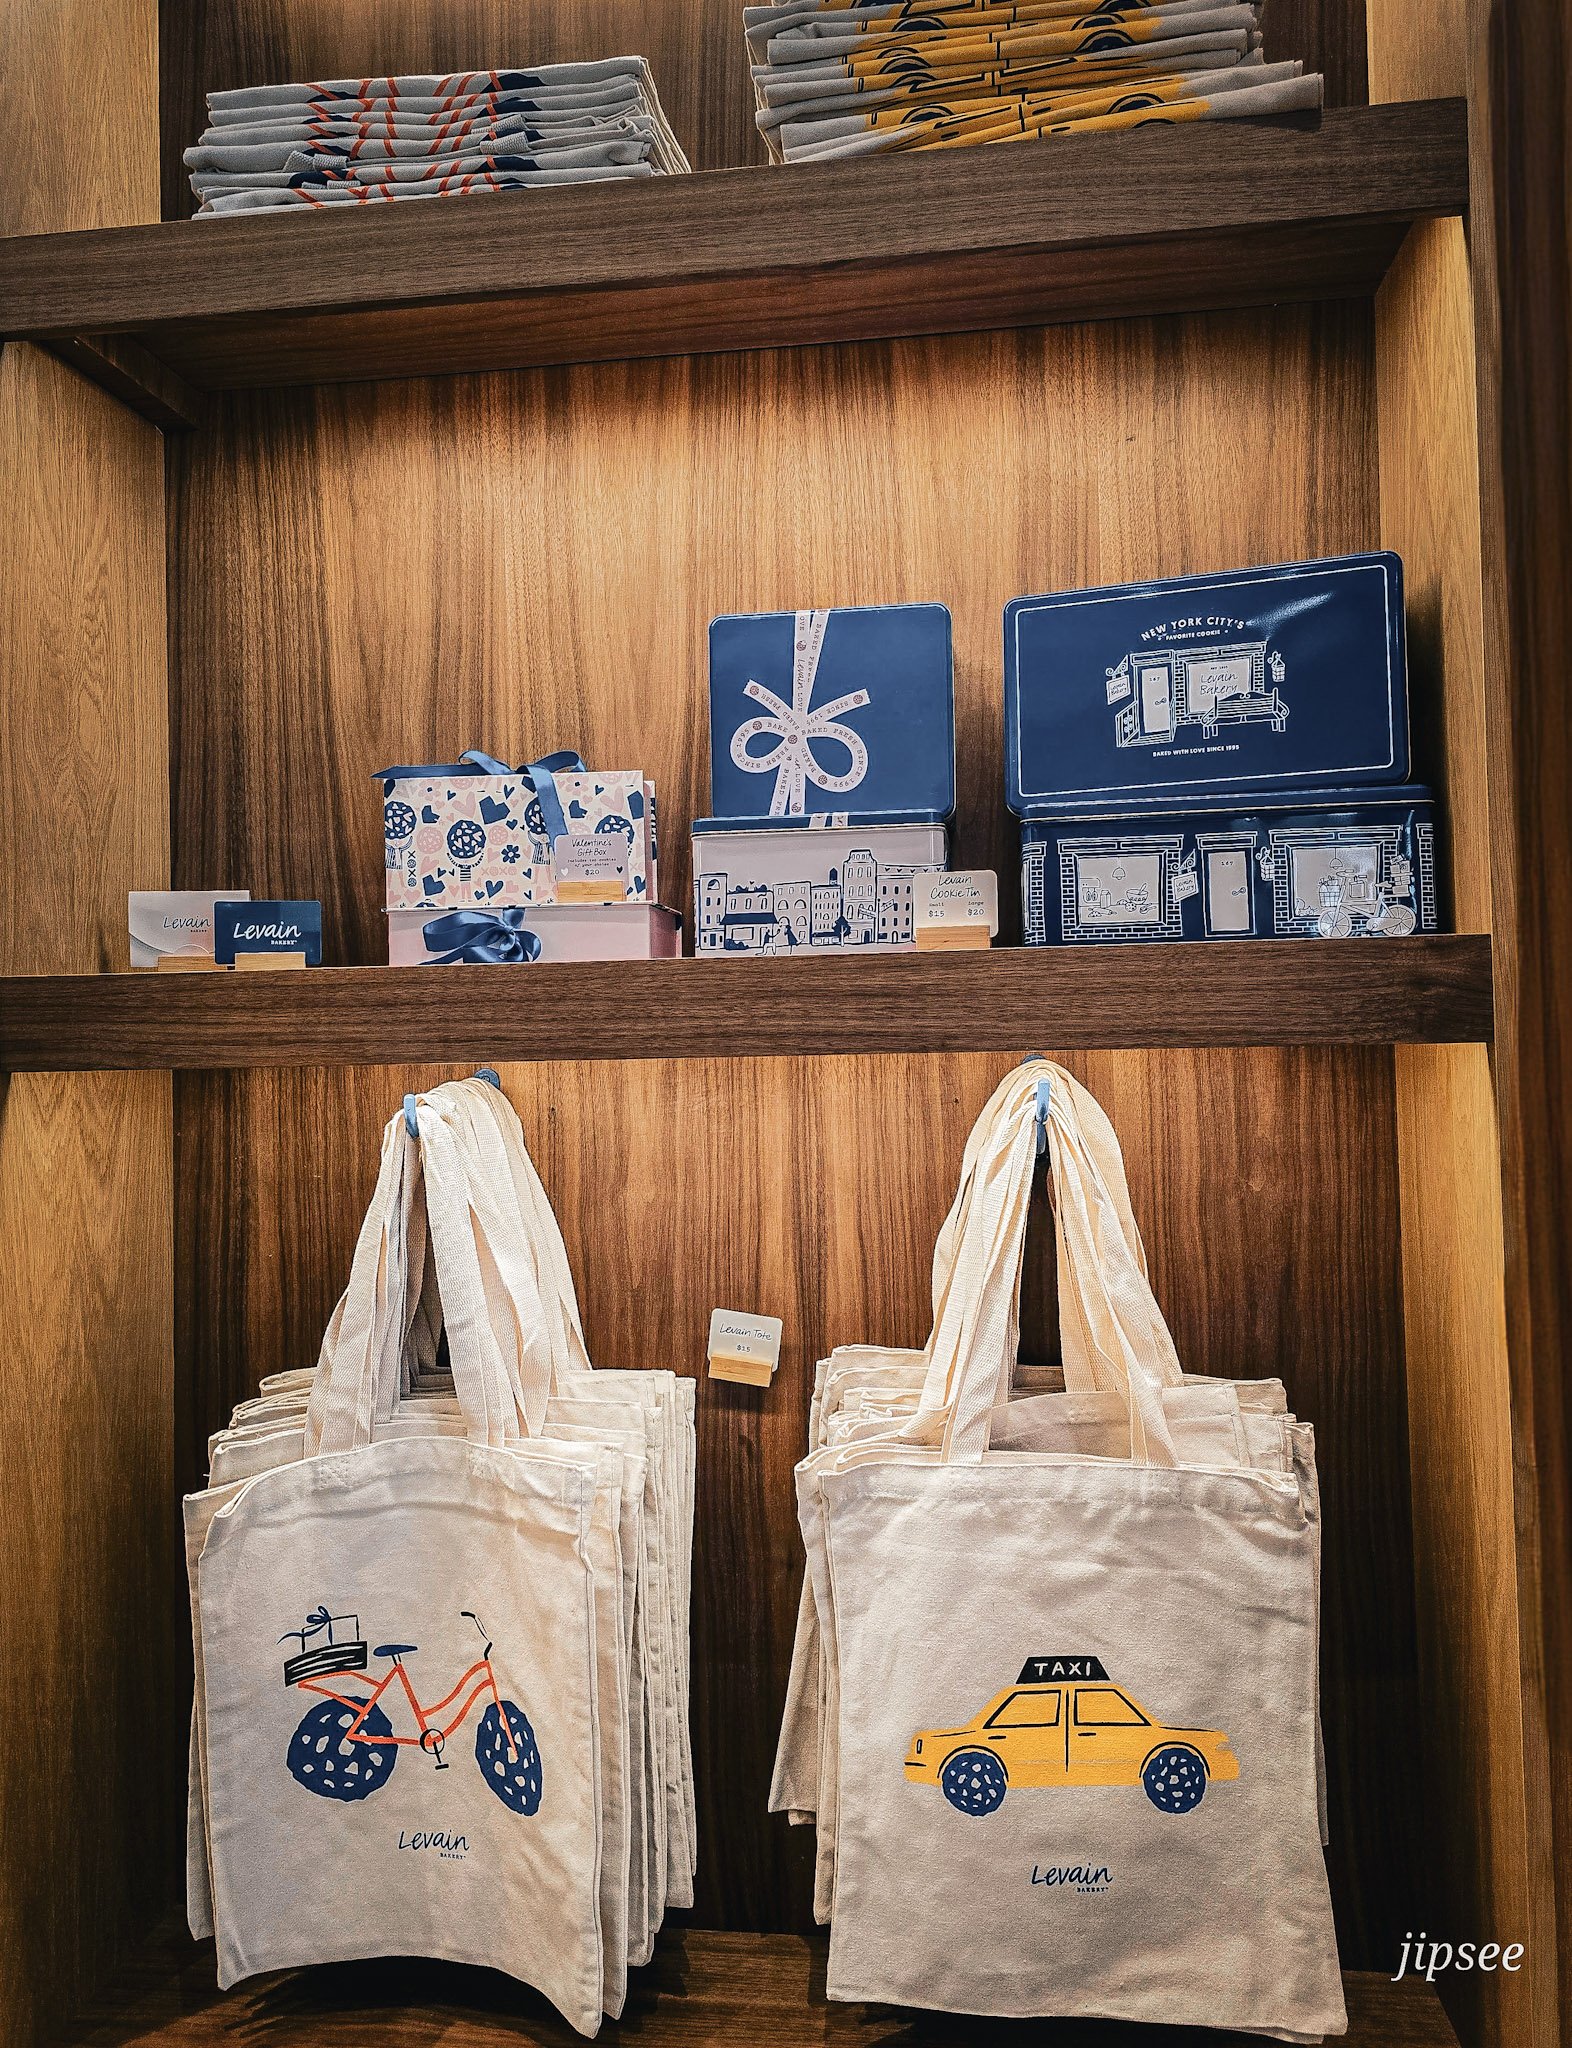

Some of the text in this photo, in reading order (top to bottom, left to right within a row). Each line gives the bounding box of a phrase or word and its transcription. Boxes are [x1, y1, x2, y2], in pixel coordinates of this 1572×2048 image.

[1140, 616, 1245, 641] NEW YORK CITY'S
[1165, 629, 1221, 641] FAVORITE COOKIE
[1200, 670, 1238, 684] Levain
[1200, 684, 1238, 695] Bakery
[1206, 745, 1225, 753] SINCE
[571, 838, 612, 847] Valentine's
[577, 847, 607, 856] Gift Box
[938, 875, 972, 886] Levain
[930, 887, 981, 900] Cookie Tin
[928, 908, 985, 918] $15 $20
[163, 915, 211, 929] Levain
[233, 921, 301, 940] Levain
[719, 1322, 772, 1341] Levain Tote
[1034, 1661, 1091, 1677] TAXI
[398, 1829, 470, 1851] Levain
[1031, 1862, 1113, 1886] Levain
